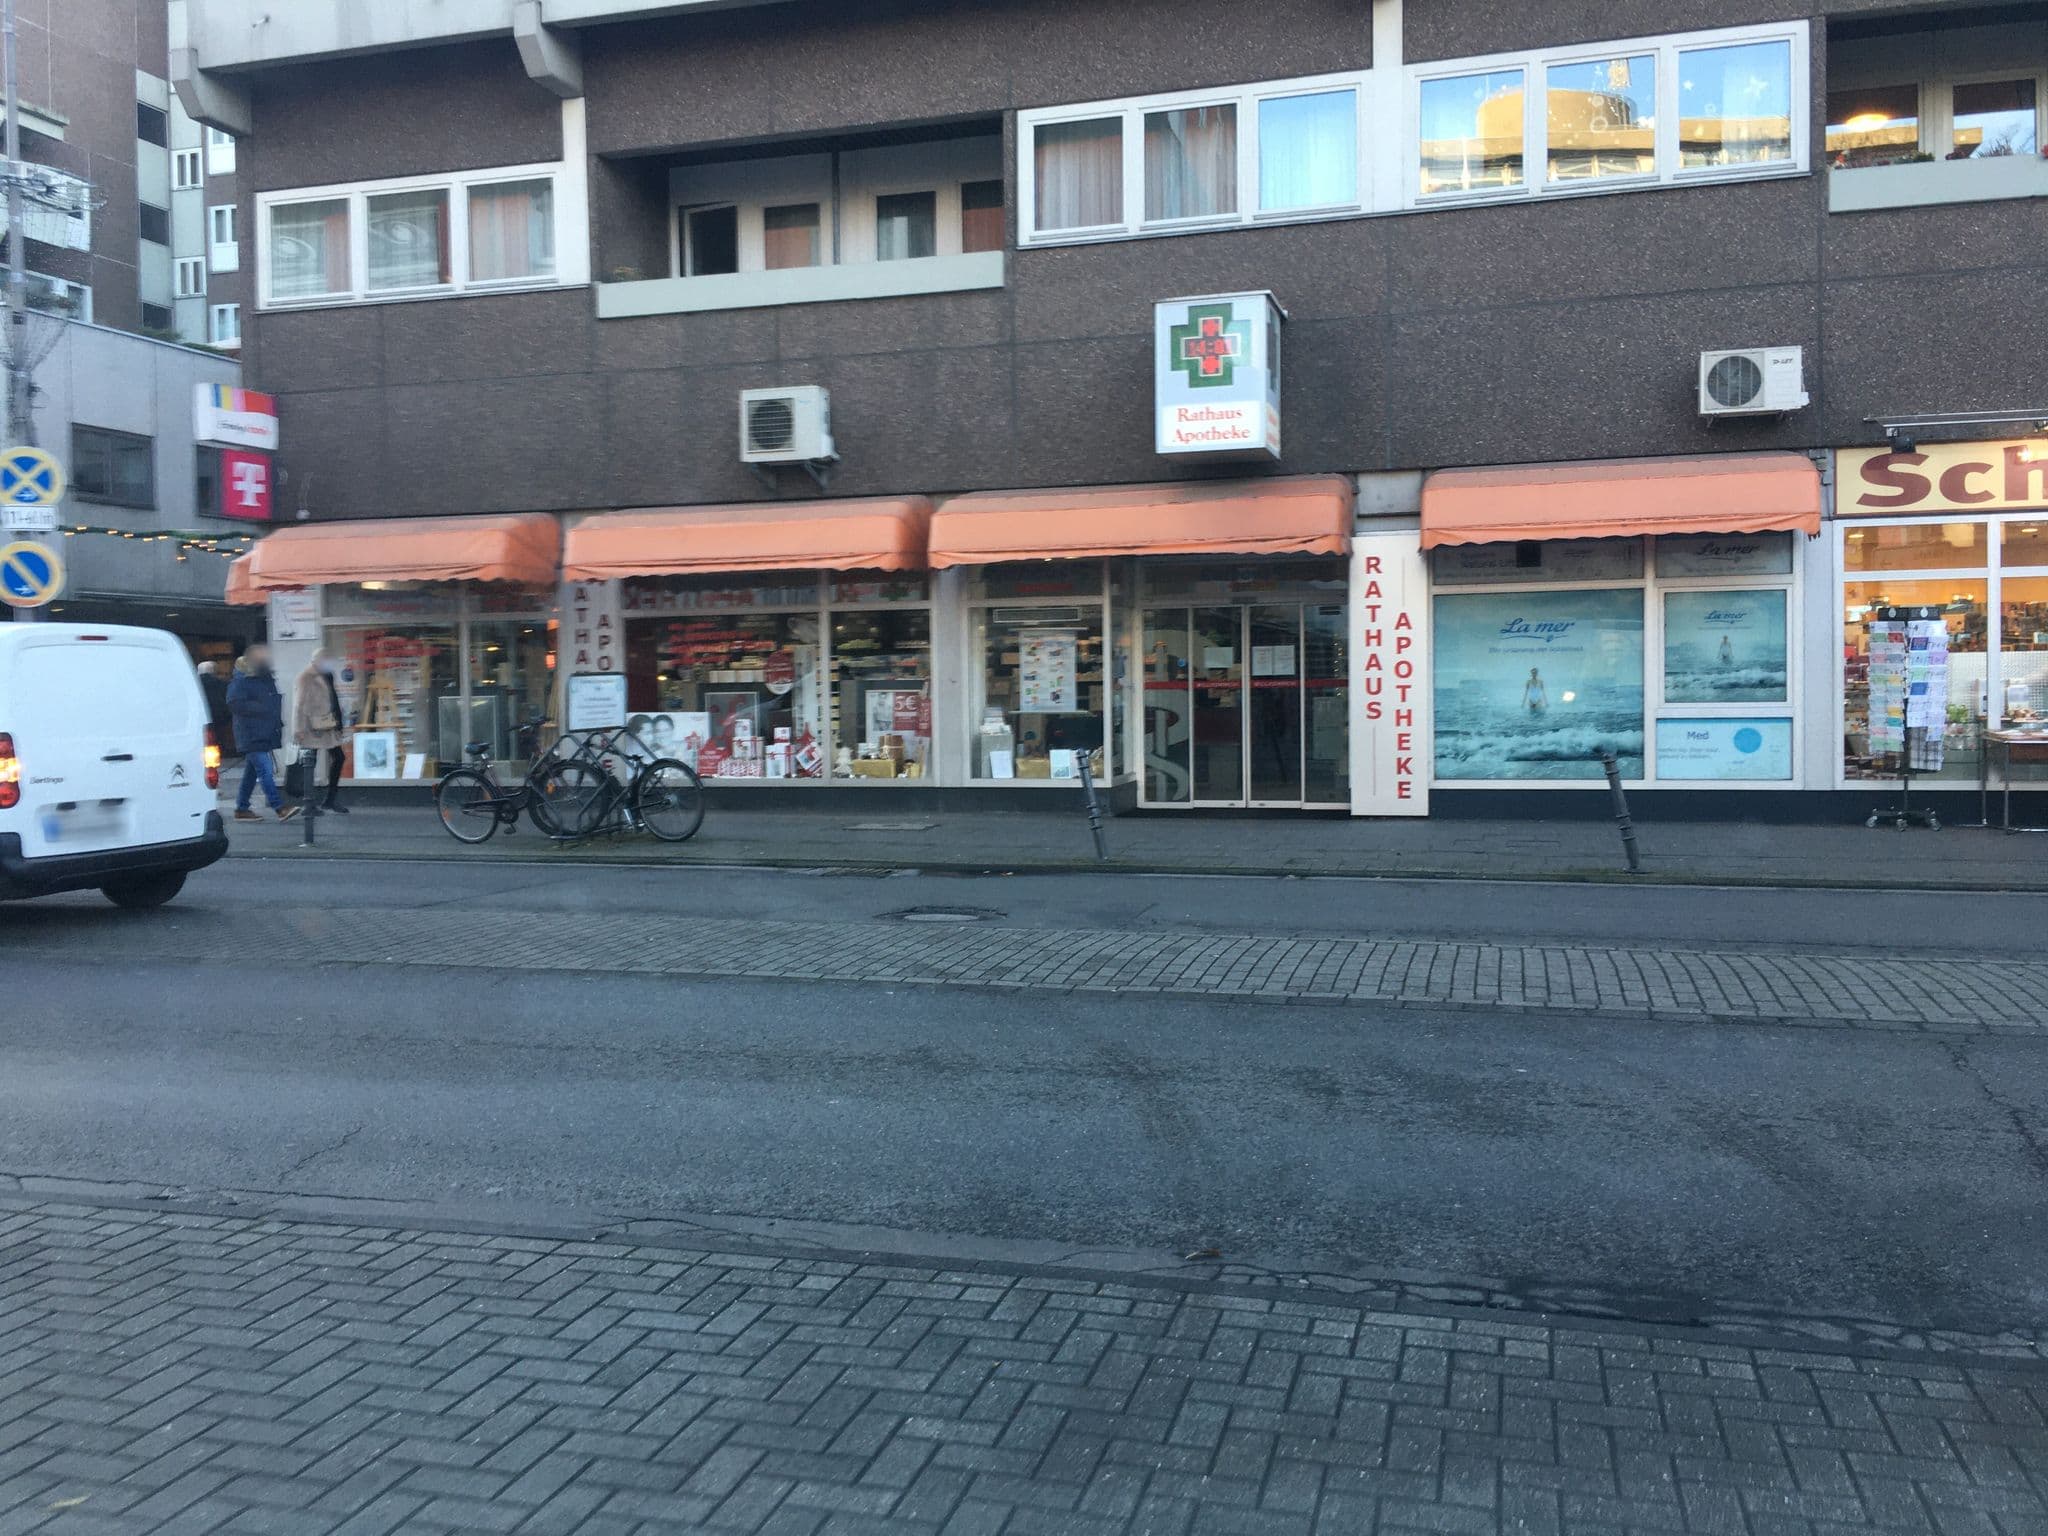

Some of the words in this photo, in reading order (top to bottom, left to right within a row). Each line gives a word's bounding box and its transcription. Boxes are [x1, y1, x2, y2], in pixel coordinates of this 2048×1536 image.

[1174, 425, 1251, 444] Apotheke
[1177, 407, 1243, 422] Rathaus
[1856, 445, 2048, 508] Sch
[575, 587, 590, 672] ATHA
[1364, 556, 1383, 720] RATHAUS
[1500, 617, 1530, 634] La
[1534, 622, 1575, 633] mer
[1394, 612, 1413, 800] APOTHEKE
[1687, 731, 1709, 740] Med
